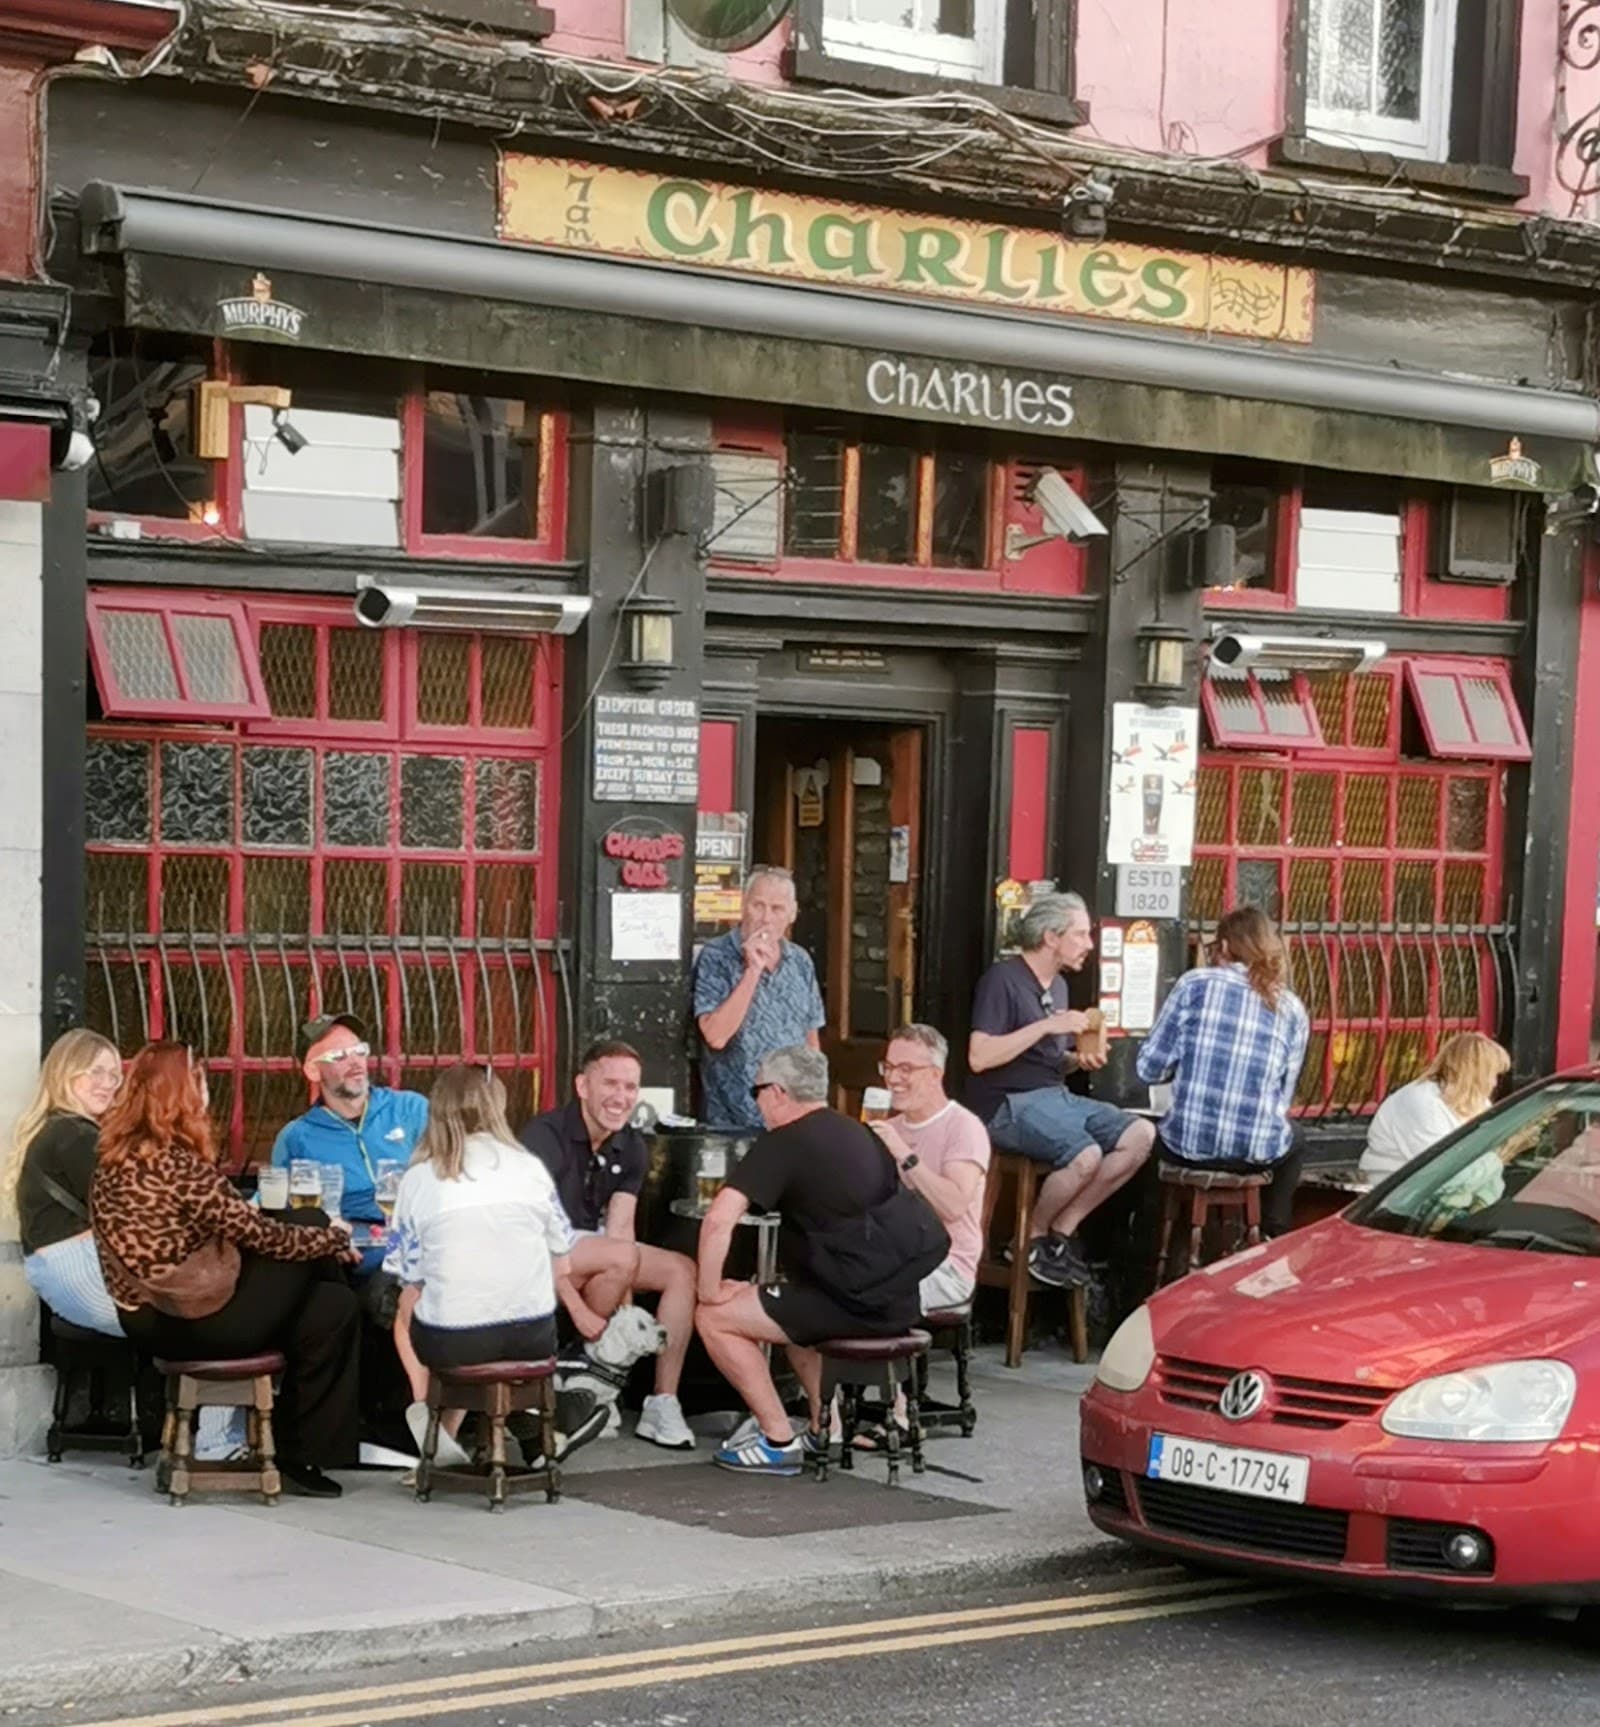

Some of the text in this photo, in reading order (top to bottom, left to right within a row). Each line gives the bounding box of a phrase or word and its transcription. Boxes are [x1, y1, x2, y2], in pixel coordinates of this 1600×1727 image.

[597, 696, 696, 717] EXEMPTION ORDER
[670, 742, 698, 755] OPEN
[596, 767, 631, 782] EXCEPT
[1131, 894, 1169, 911] 1820
[1171, 1447, 1291, 1494] 08-C-17794
